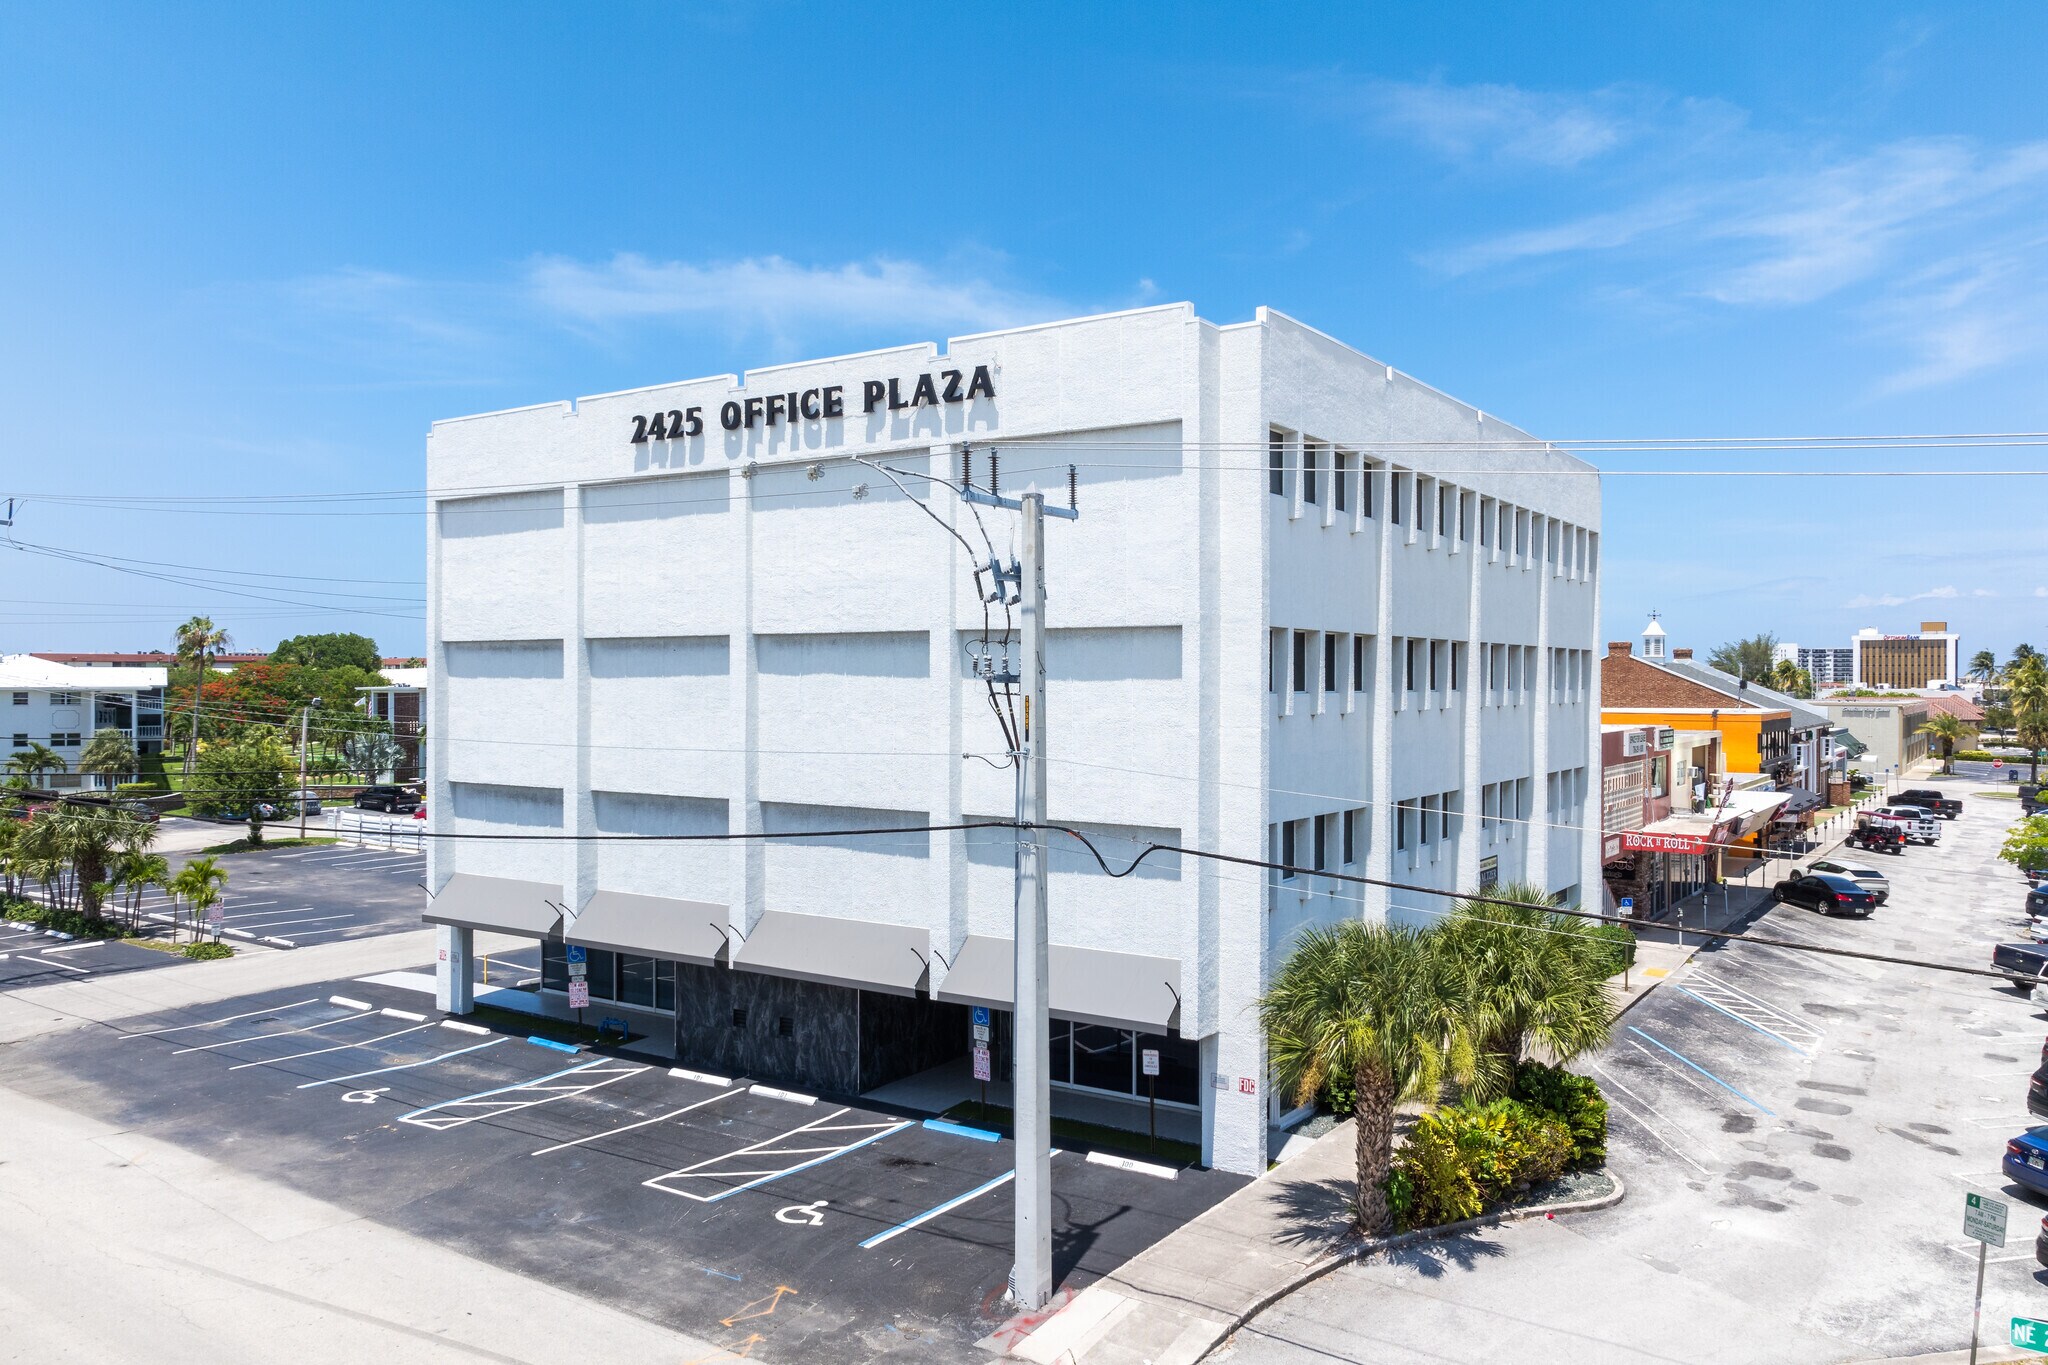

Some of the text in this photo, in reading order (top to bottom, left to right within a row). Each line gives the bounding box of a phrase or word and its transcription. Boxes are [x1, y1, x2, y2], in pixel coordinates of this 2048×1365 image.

[630, 365, 996, 443] 2425 OFFICE PLAZA
[1626, 834, 1654, 847] ROCK
[1663, 836, 1690, 850] ROLL
[1240, 1078, 1255, 1093] FDC
[1971, 1196, 1976, 1205] 4
[2014, 1323, 2037, 1345] NE
